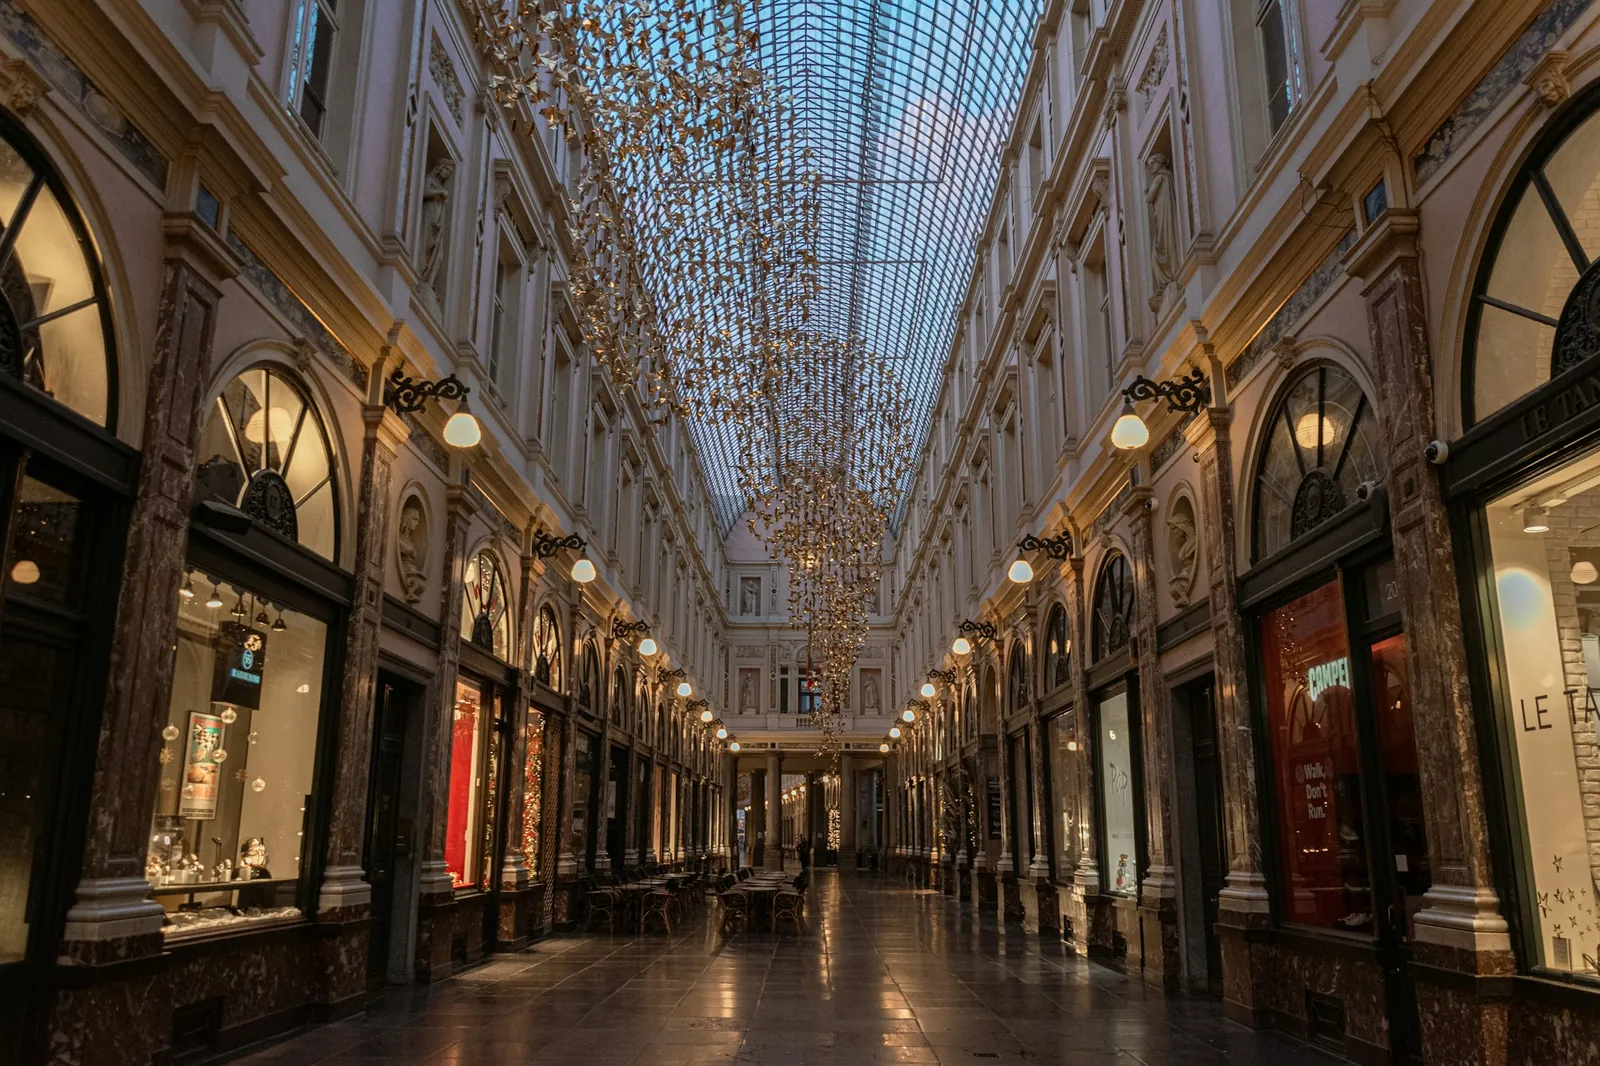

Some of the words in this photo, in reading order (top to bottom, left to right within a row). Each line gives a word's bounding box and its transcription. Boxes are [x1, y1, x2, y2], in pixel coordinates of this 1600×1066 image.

[1520, 405, 1552, 442] LE
[1520, 694, 1552, 732] LE
[1303, 761, 1327, 780] Walk,
[1306, 782, 1328, 800] Don't
[1308, 803, 1326, 819] Run.
